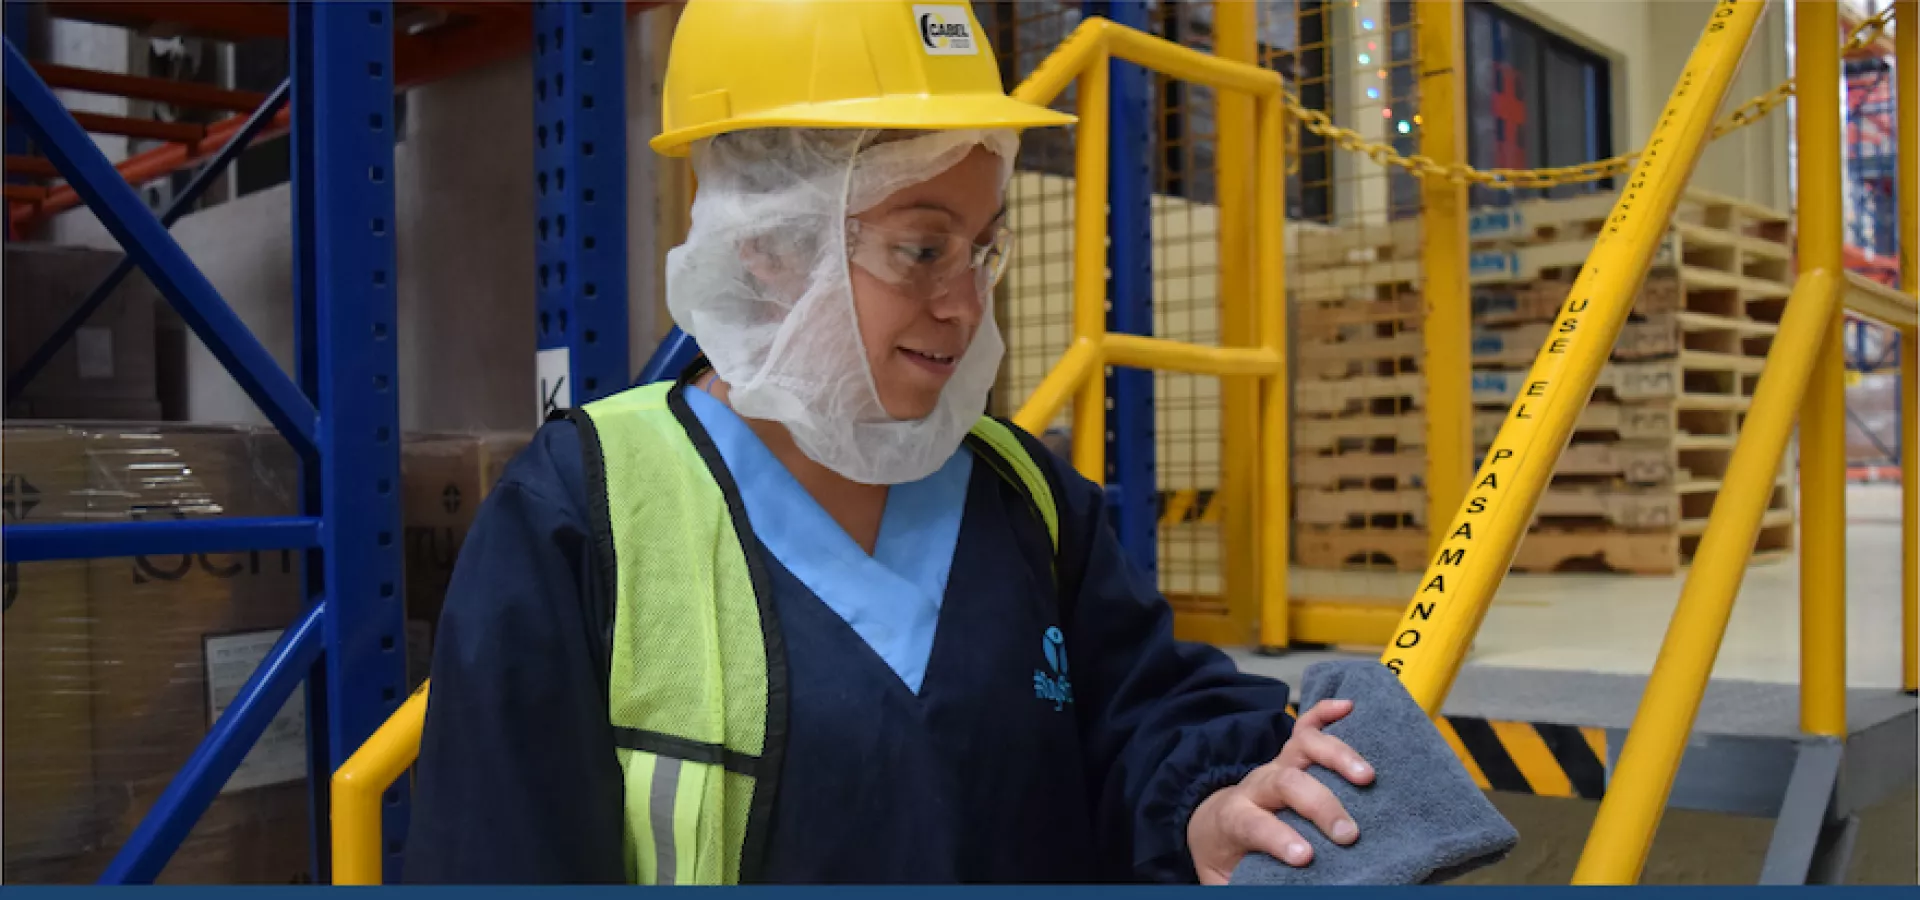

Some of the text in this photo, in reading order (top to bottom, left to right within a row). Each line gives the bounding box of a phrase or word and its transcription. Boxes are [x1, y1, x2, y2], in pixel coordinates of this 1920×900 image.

[929, 23, 970, 38] CABEL
[541, 376, 566, 417] K
[1387, 299, 1589, 675] USE EL PASAMANOS
